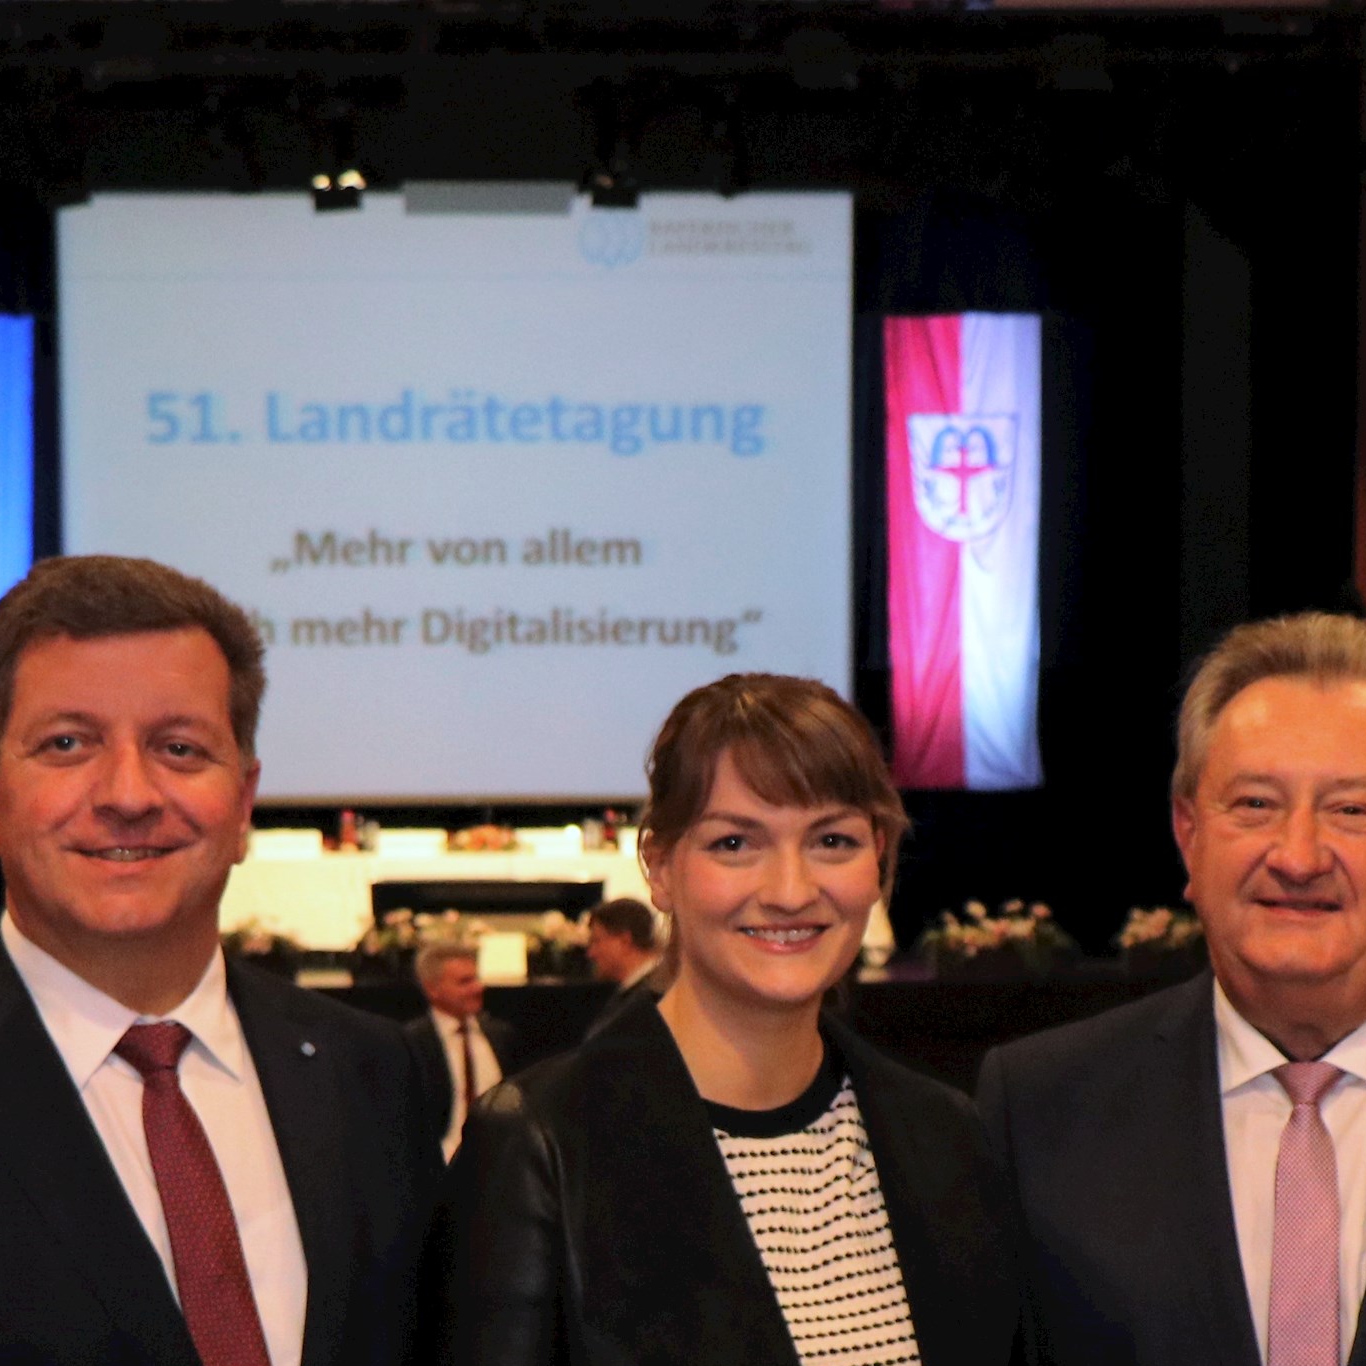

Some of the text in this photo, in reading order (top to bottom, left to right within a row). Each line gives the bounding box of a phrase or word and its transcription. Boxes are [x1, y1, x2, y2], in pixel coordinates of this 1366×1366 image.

[146, 388, 767, 457] 51. Landrätetagung
[269, 528, 643, 573] „Mehr von allem
[290, 607, 404, 646] mehr
[420, 606, 764, 655] Digitalisierung“
